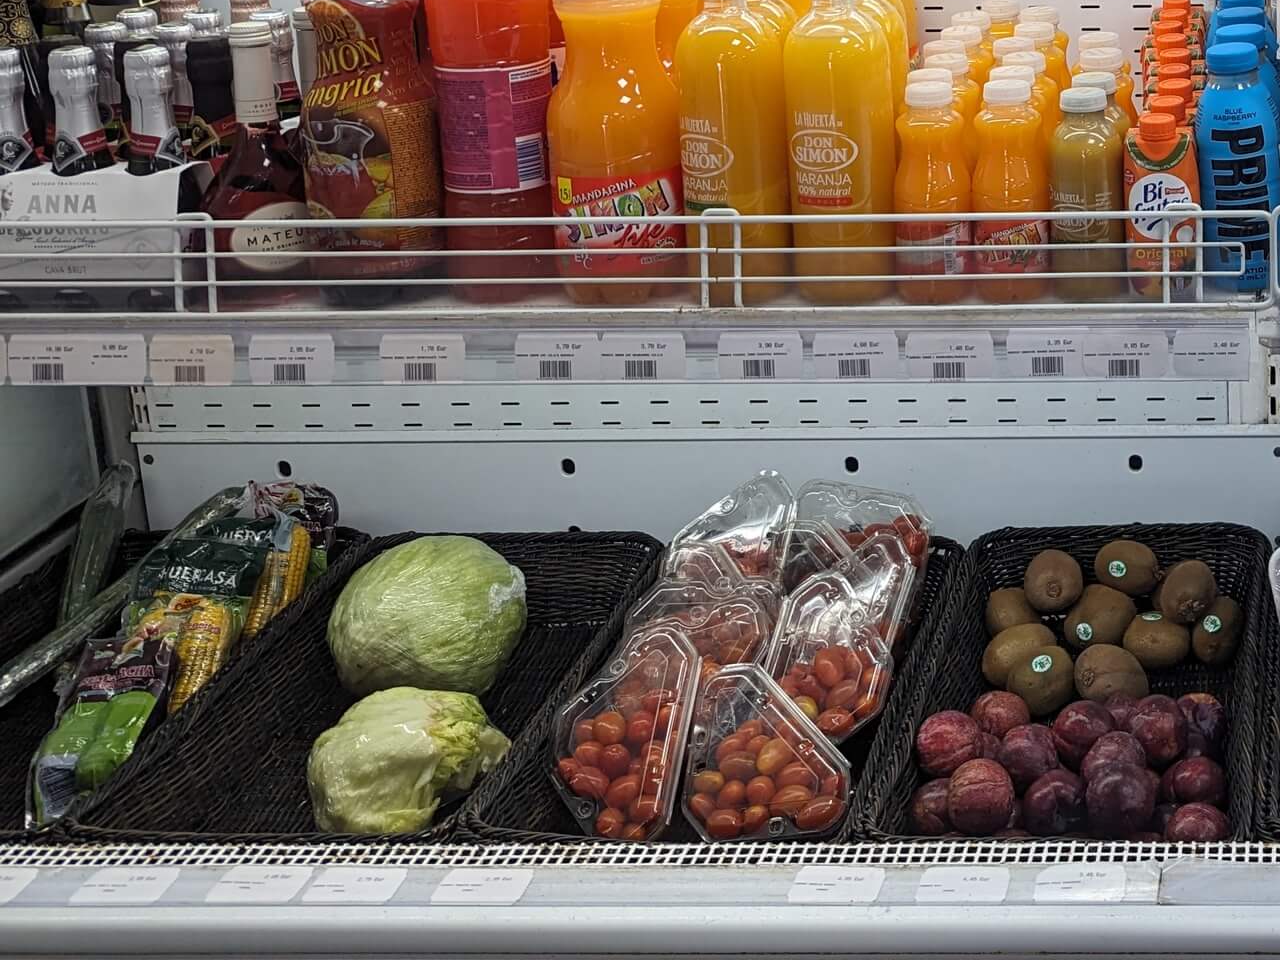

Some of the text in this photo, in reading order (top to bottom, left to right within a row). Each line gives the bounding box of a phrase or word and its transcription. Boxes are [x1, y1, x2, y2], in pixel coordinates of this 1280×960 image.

[316, 36, 384, 80] IMON
[803, 111, 836, 128] HUERTA
[1213, 112, 1257, 122] RASPBERRY
[686, 141, 709, 155] DON
[804, 136, 833, 148] DON
[795, 147, 848, 163] SIMON
[684, 176, 728, 191] ARANJA
[818, 186, 852, 197] natural
[571, 178, 638, 206] MANDARINA
[27, 194, 97, 214] ANNA
[246, 227, 303, 247] MATEU
[1135, 247, 1188, 260] Origal
[158, 565, 238, 587] HUERCASA
